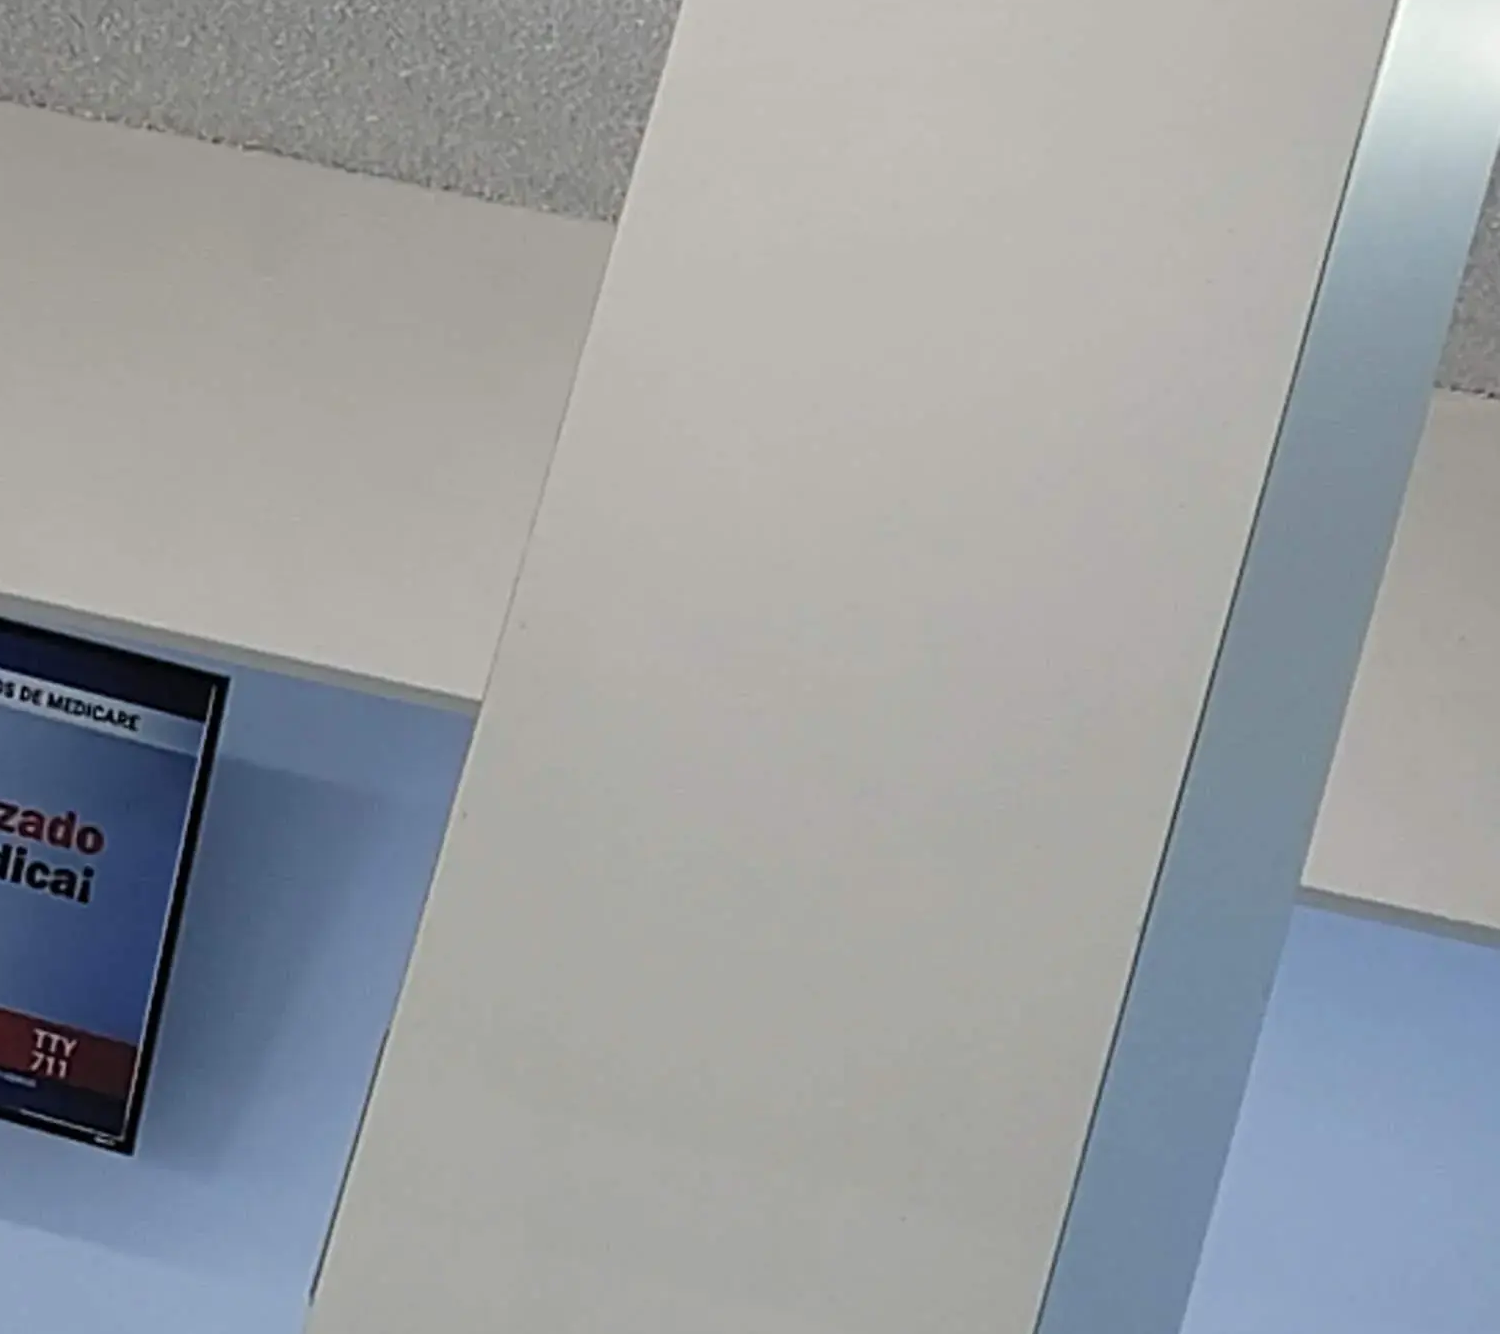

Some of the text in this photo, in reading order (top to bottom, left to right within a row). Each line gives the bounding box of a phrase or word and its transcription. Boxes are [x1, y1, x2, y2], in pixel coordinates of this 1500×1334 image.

[19, 685, 44, 707] DE
[46, 693, 143, 733] MEDICARE
[31, 1027, 79, 1059] TTY
[28, 1051, 69, 1080] 711
